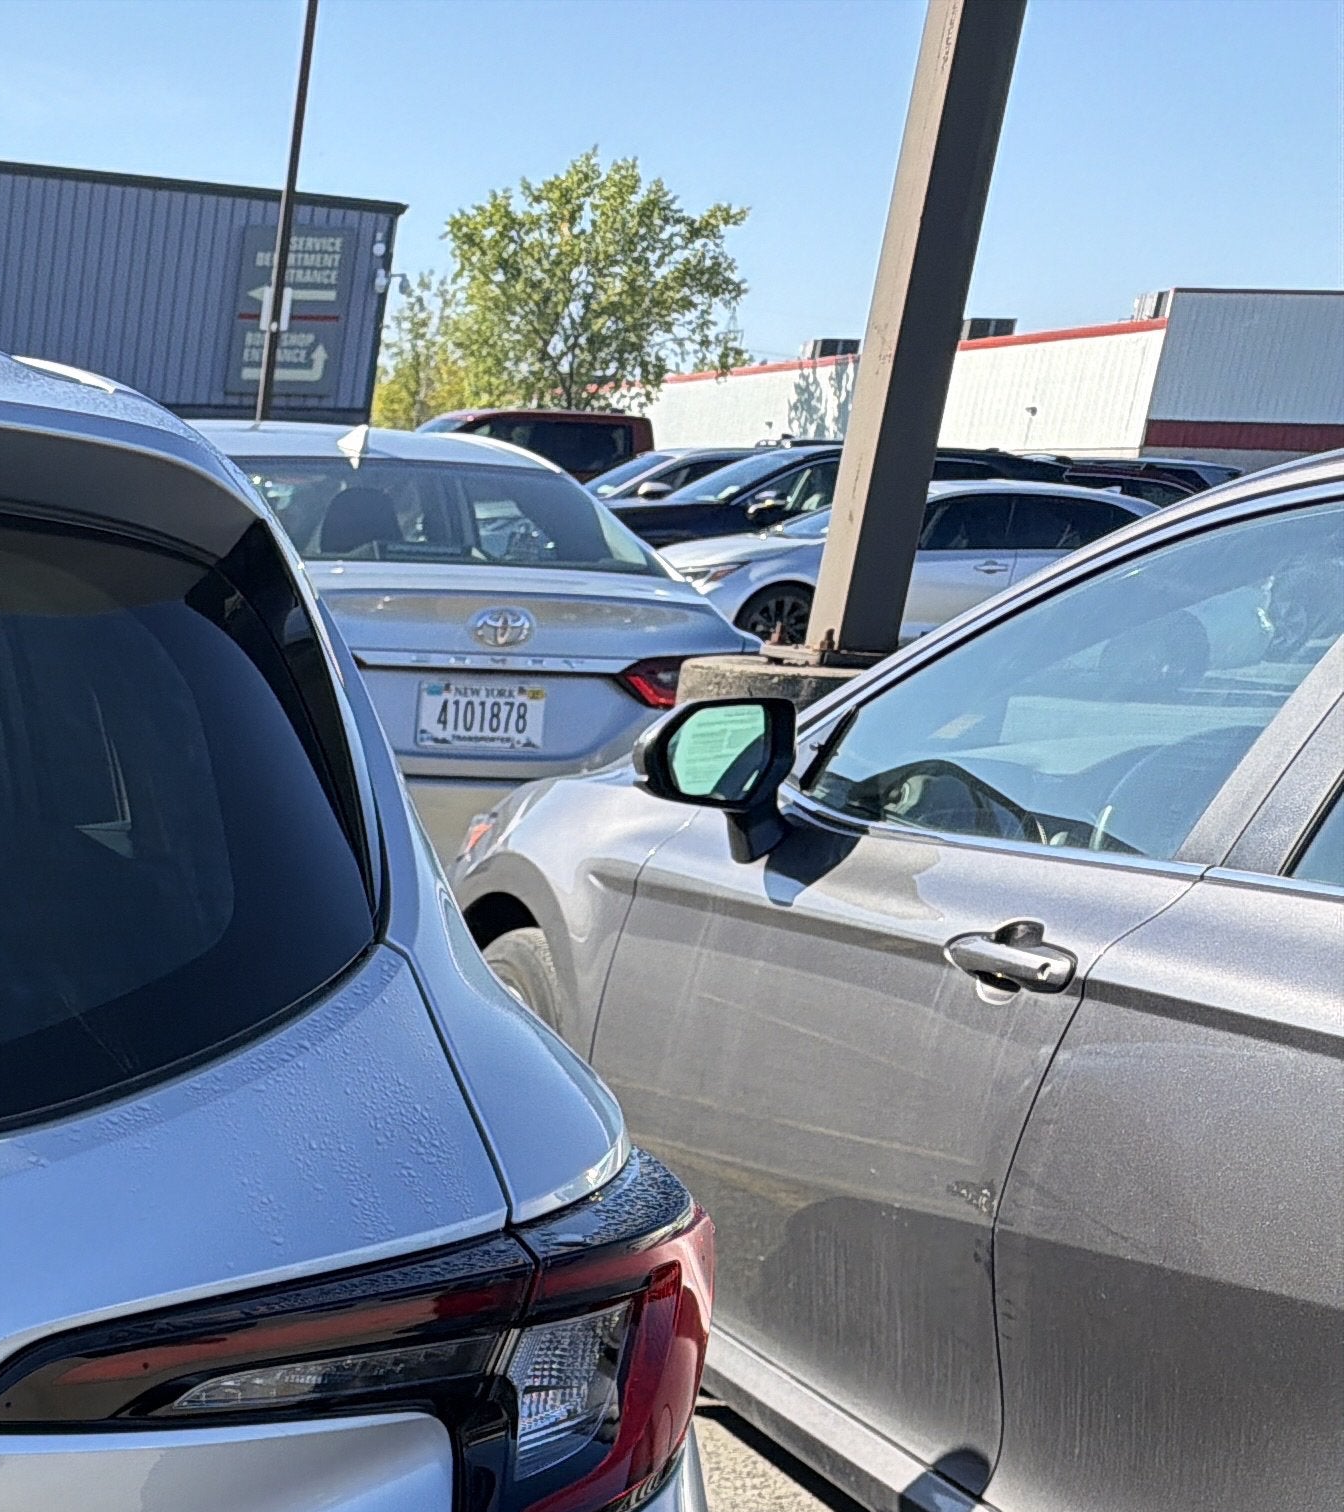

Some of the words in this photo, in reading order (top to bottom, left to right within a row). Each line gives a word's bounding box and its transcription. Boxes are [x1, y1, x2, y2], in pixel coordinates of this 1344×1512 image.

[289, 236, 342, 252] SERVICE
[255, 252, 341, 268] DERTMENT
[280, 332, 316, 348] SHOP
[243, 347, 307, 363] ENANCE
[454, 686, 481, 698] NEW
[485, 687, 516, 699] YORK
[436, 698, 528, 735] 4101878
